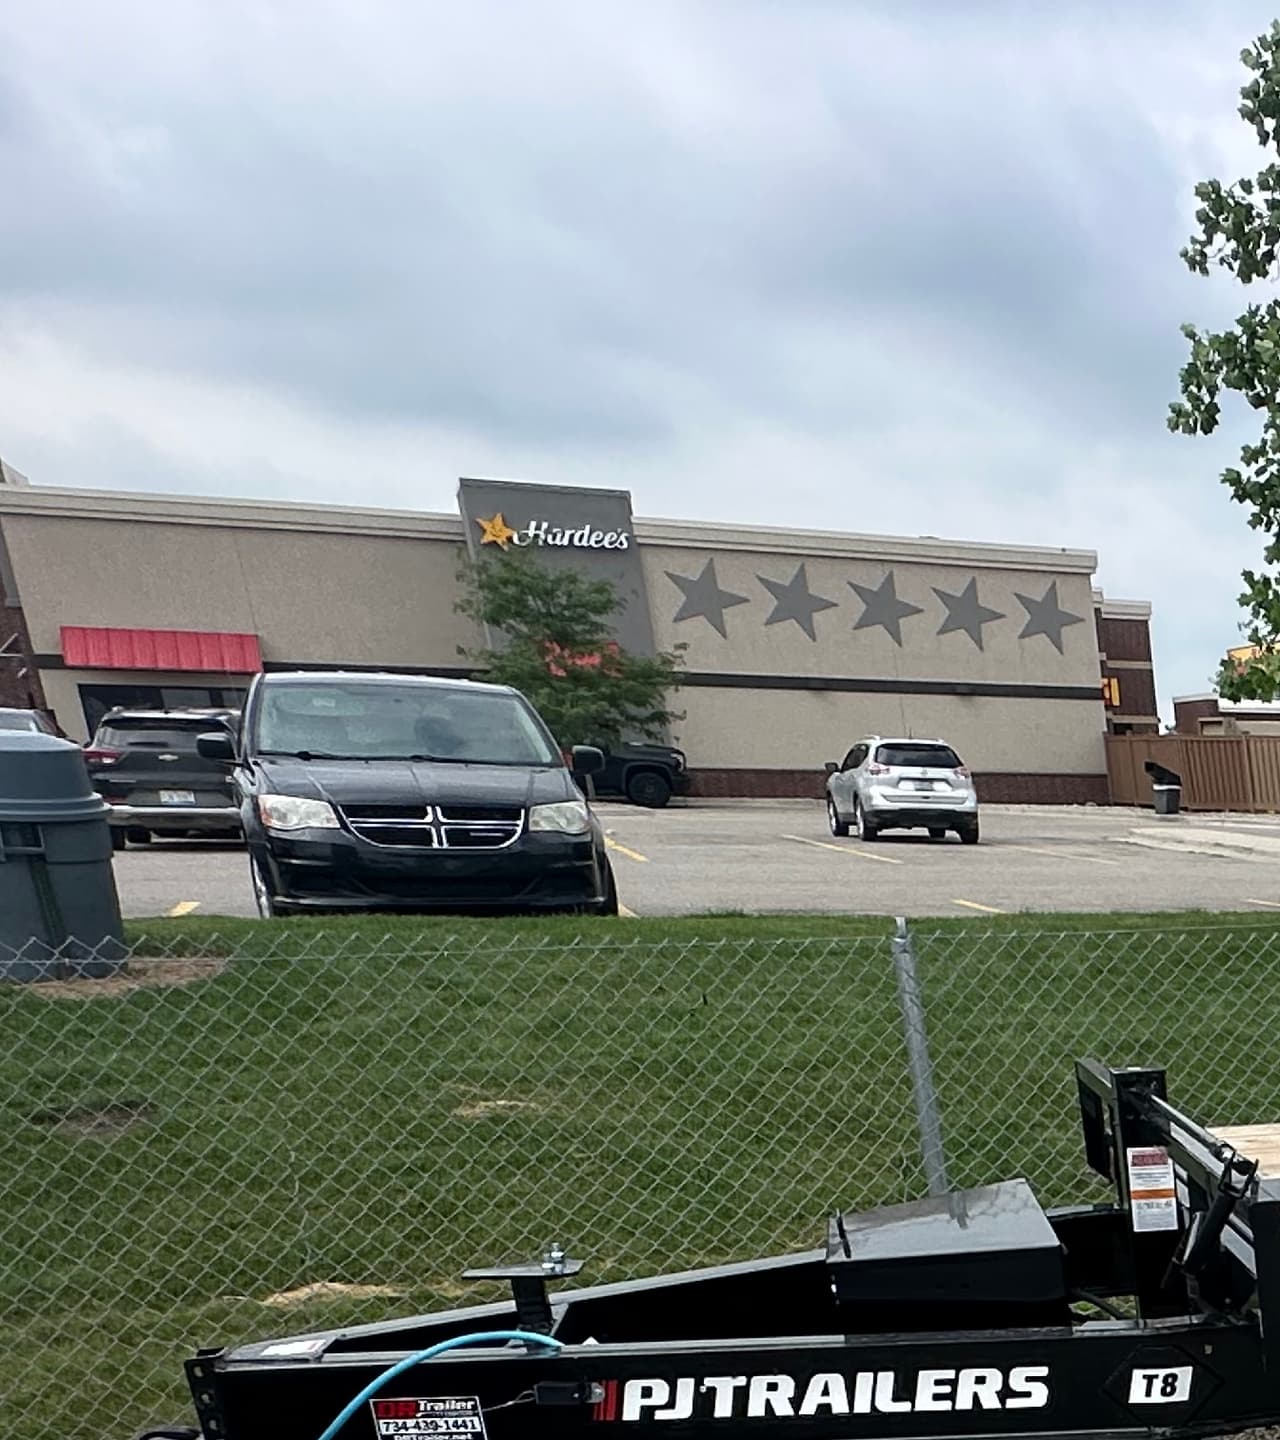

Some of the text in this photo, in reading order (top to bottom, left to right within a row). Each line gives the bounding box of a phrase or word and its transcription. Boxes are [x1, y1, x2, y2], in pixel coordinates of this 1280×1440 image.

[512, 520, 630, 549] Hardee's
[1142, 1372, 1178, 1398] T8
[418, 1400, 475, 1411] Trailer
